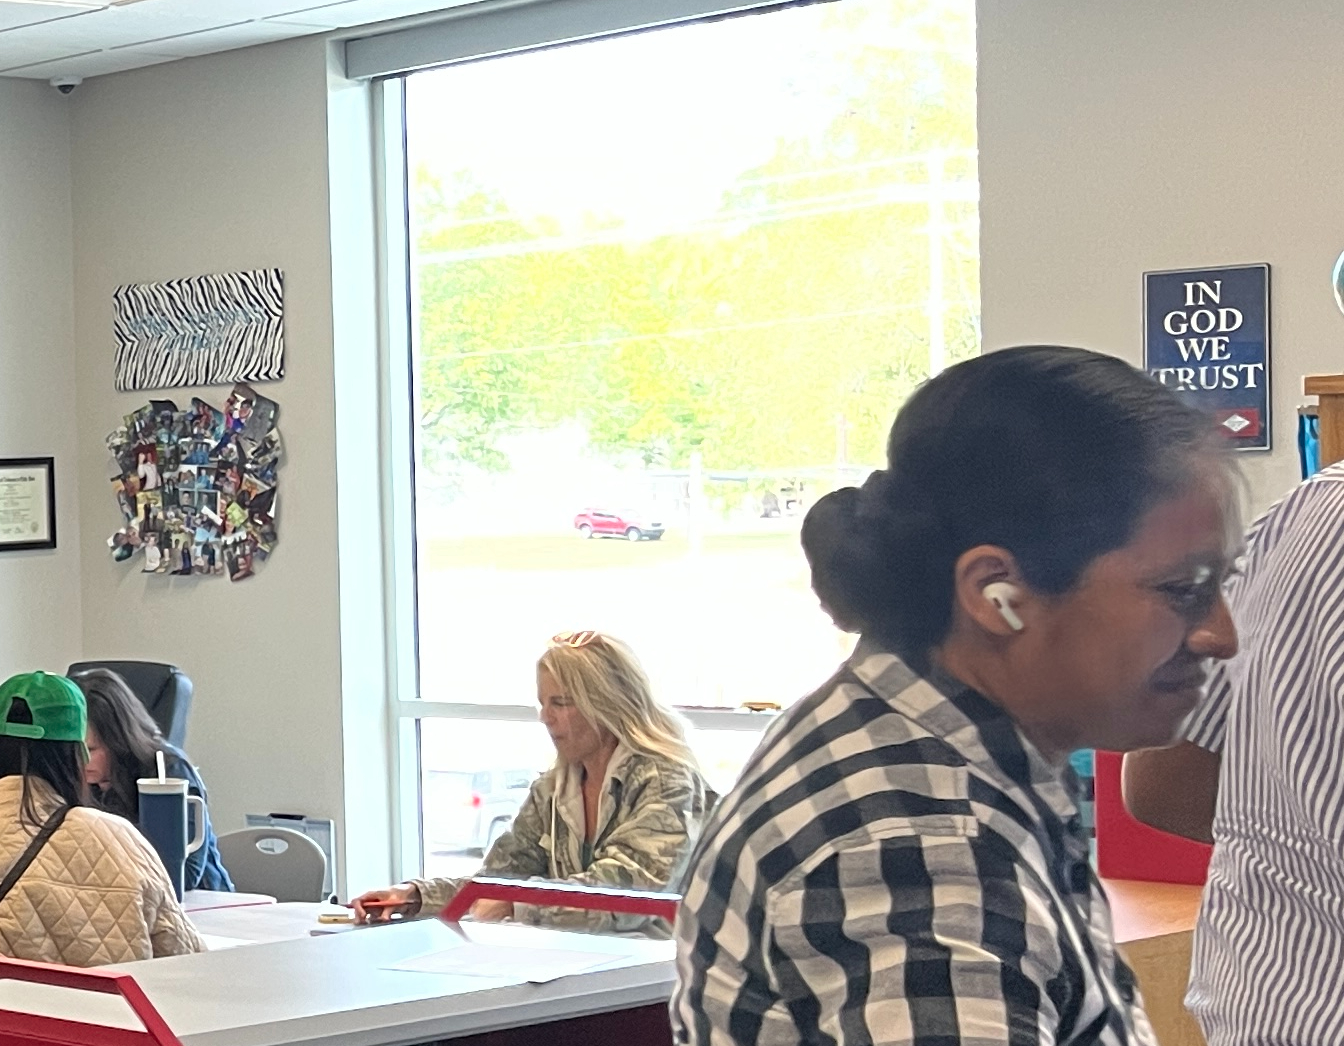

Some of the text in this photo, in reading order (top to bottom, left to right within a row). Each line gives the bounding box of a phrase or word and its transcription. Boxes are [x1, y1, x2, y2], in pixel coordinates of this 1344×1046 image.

[1184, 281, 1222, 306] IN
[1164, 308, 1243, 335] GOD
[1175, 336, 1231, 362] WE
[1150, 362, 1263, 391] TRUST
